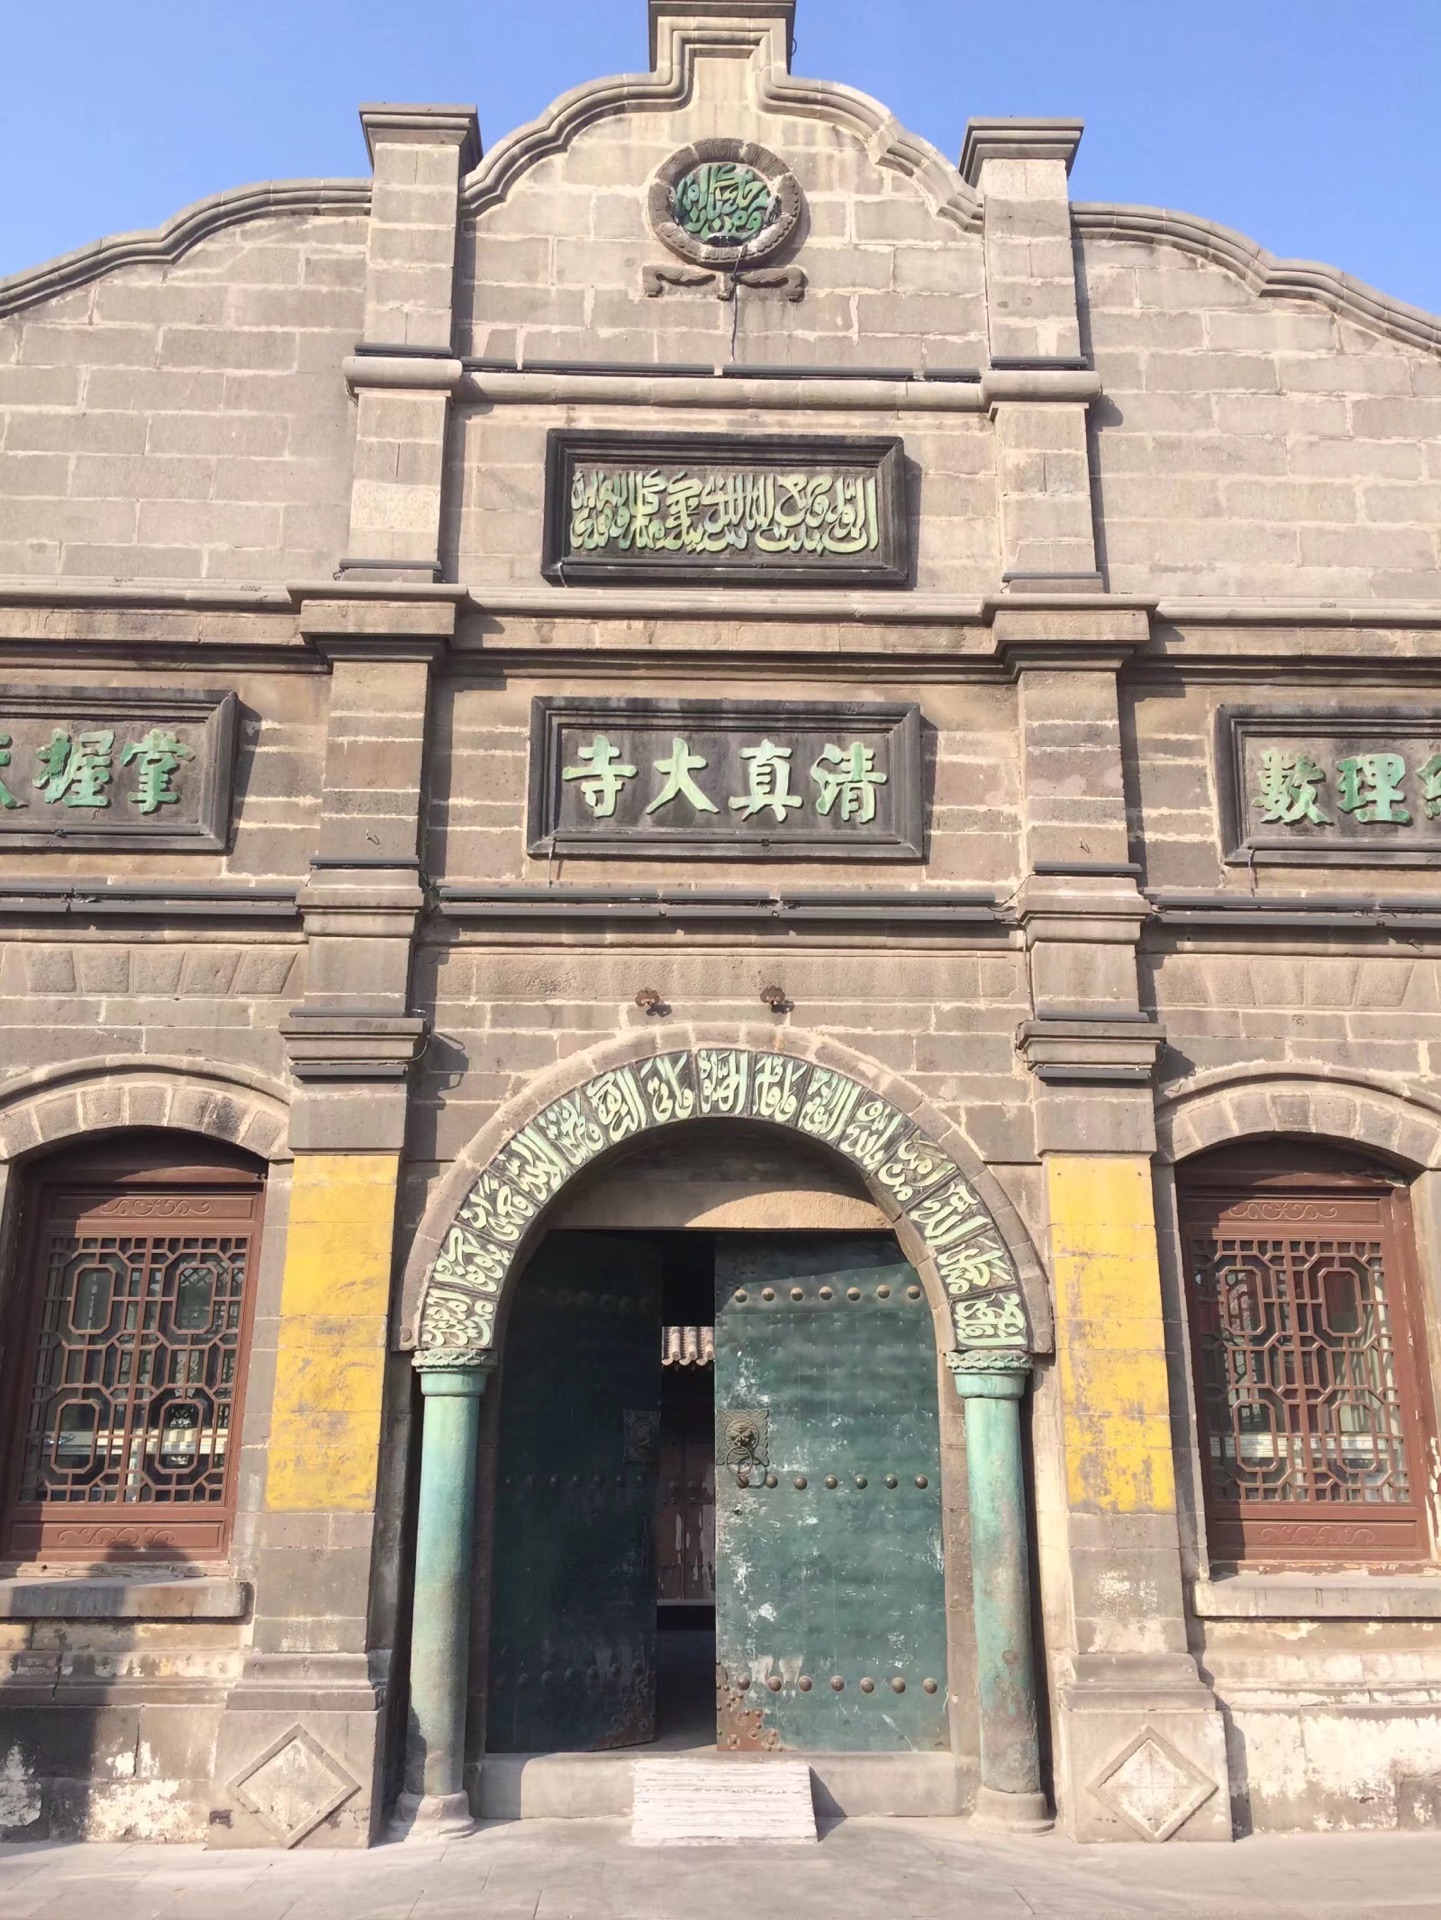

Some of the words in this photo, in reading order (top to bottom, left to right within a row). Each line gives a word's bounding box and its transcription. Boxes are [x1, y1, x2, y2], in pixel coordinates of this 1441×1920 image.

[562, 733, 888, 824] 清真大寺
[1251, 747, 1441, 826] 理數
